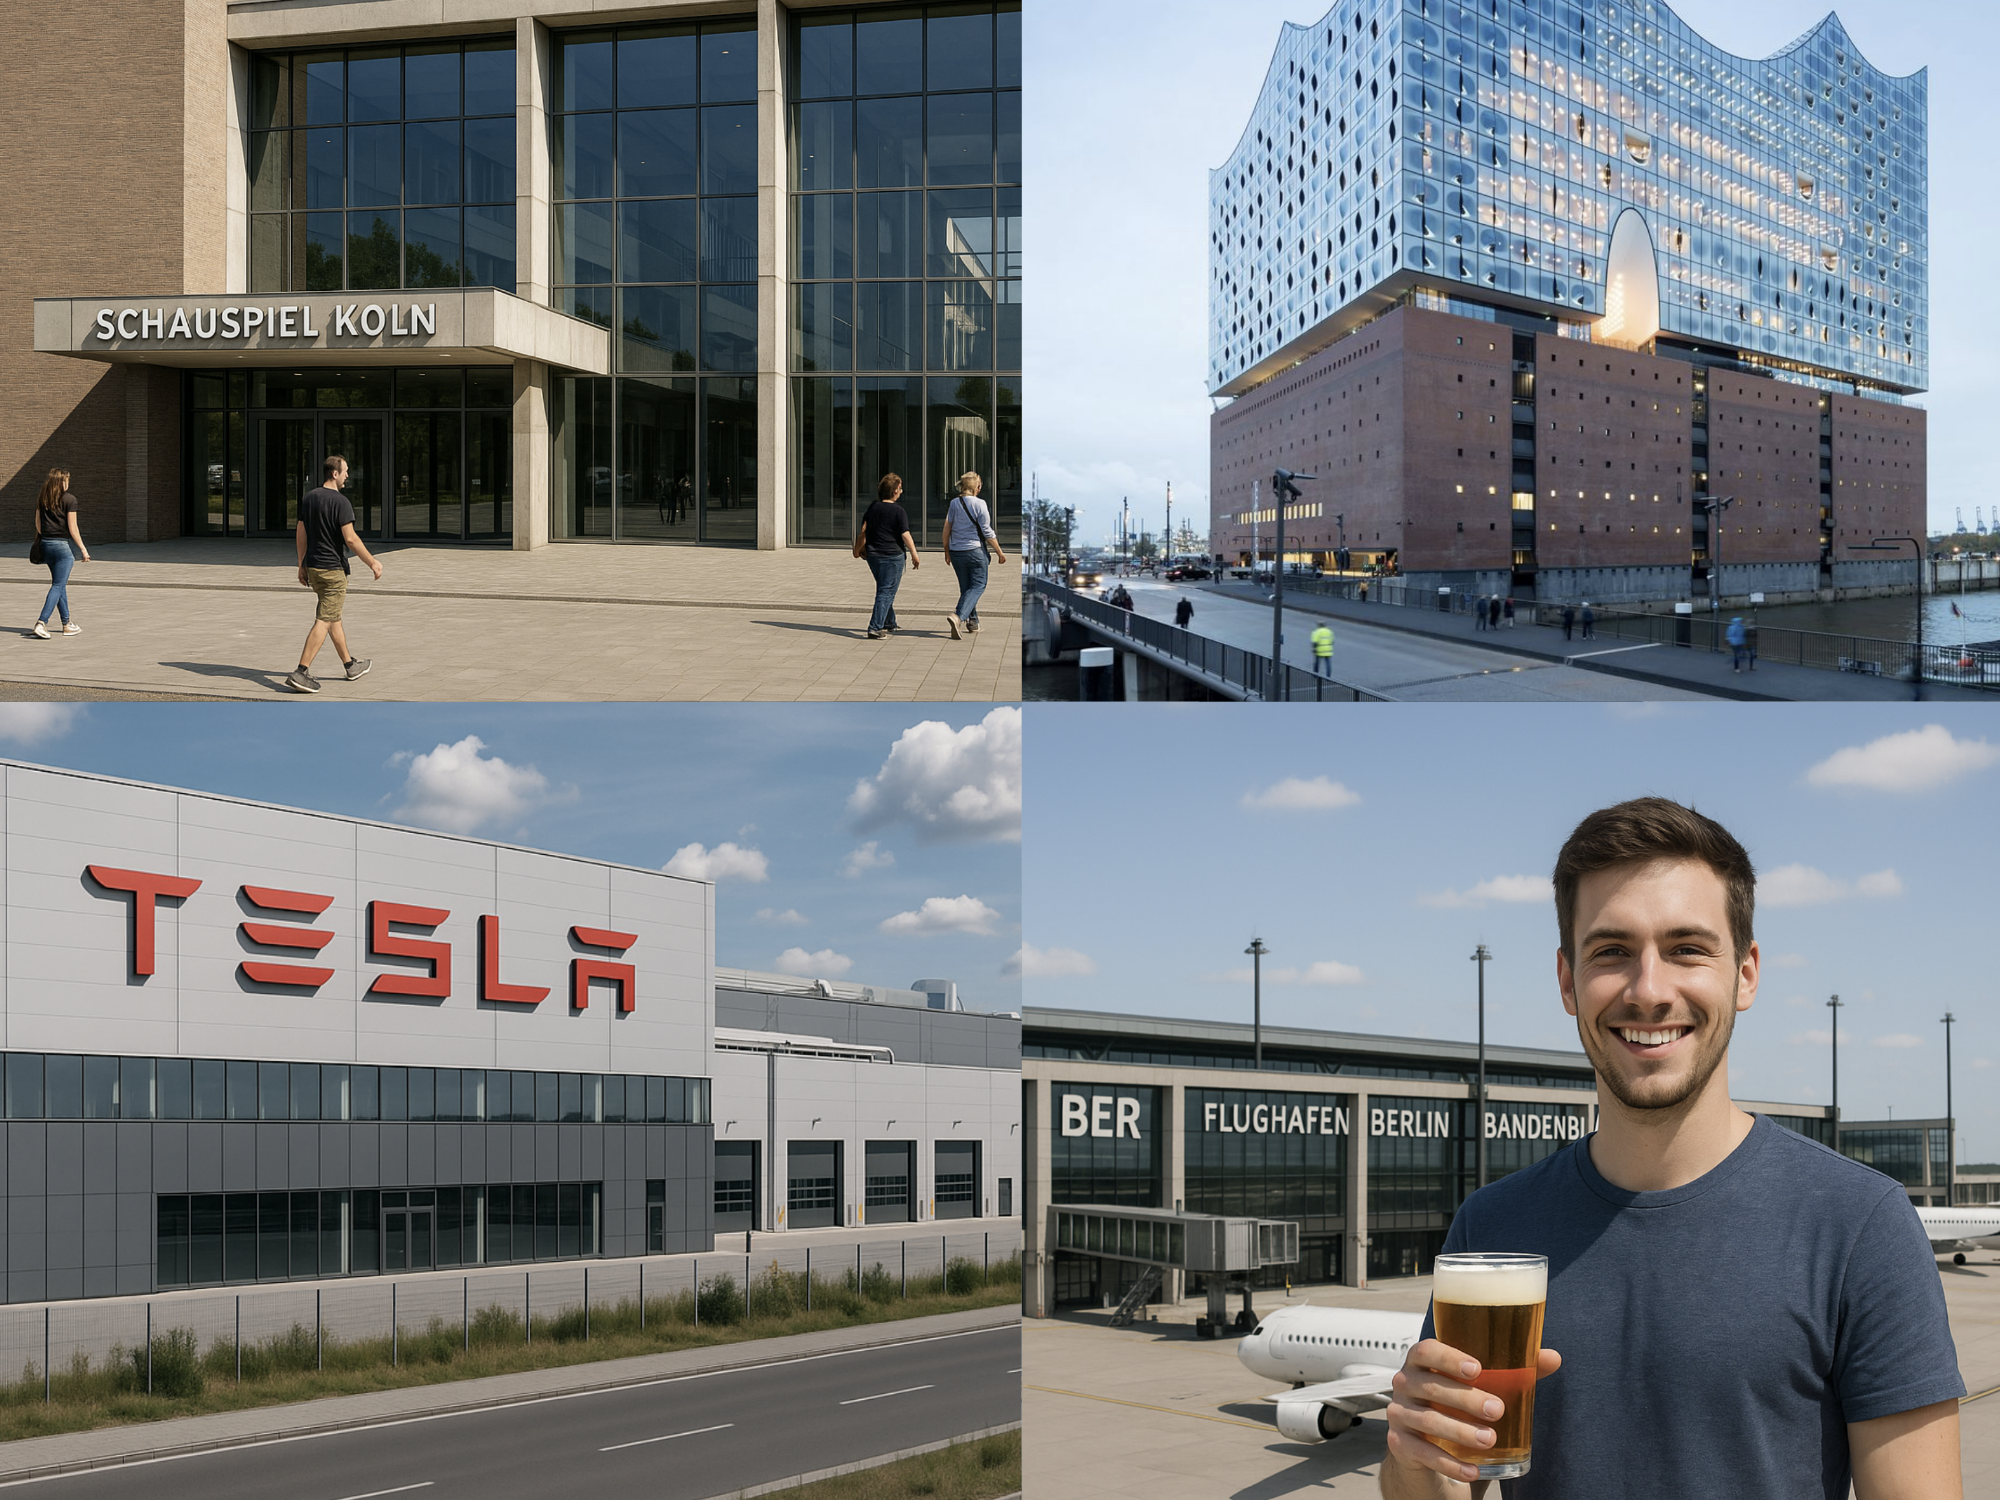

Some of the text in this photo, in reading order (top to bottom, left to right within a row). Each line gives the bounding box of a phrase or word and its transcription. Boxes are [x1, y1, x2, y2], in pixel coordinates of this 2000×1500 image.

[96, 303, 436, 340] SCHAUSPIEL KOLN
[86, 865, 638, 1013] TESLA
[1061, 1094, 1142, 1140] BER
[1204, 1102, 1349, 1135] FLUGHAFEN
[1371, 1108, 1449, 1138] BERLIN
